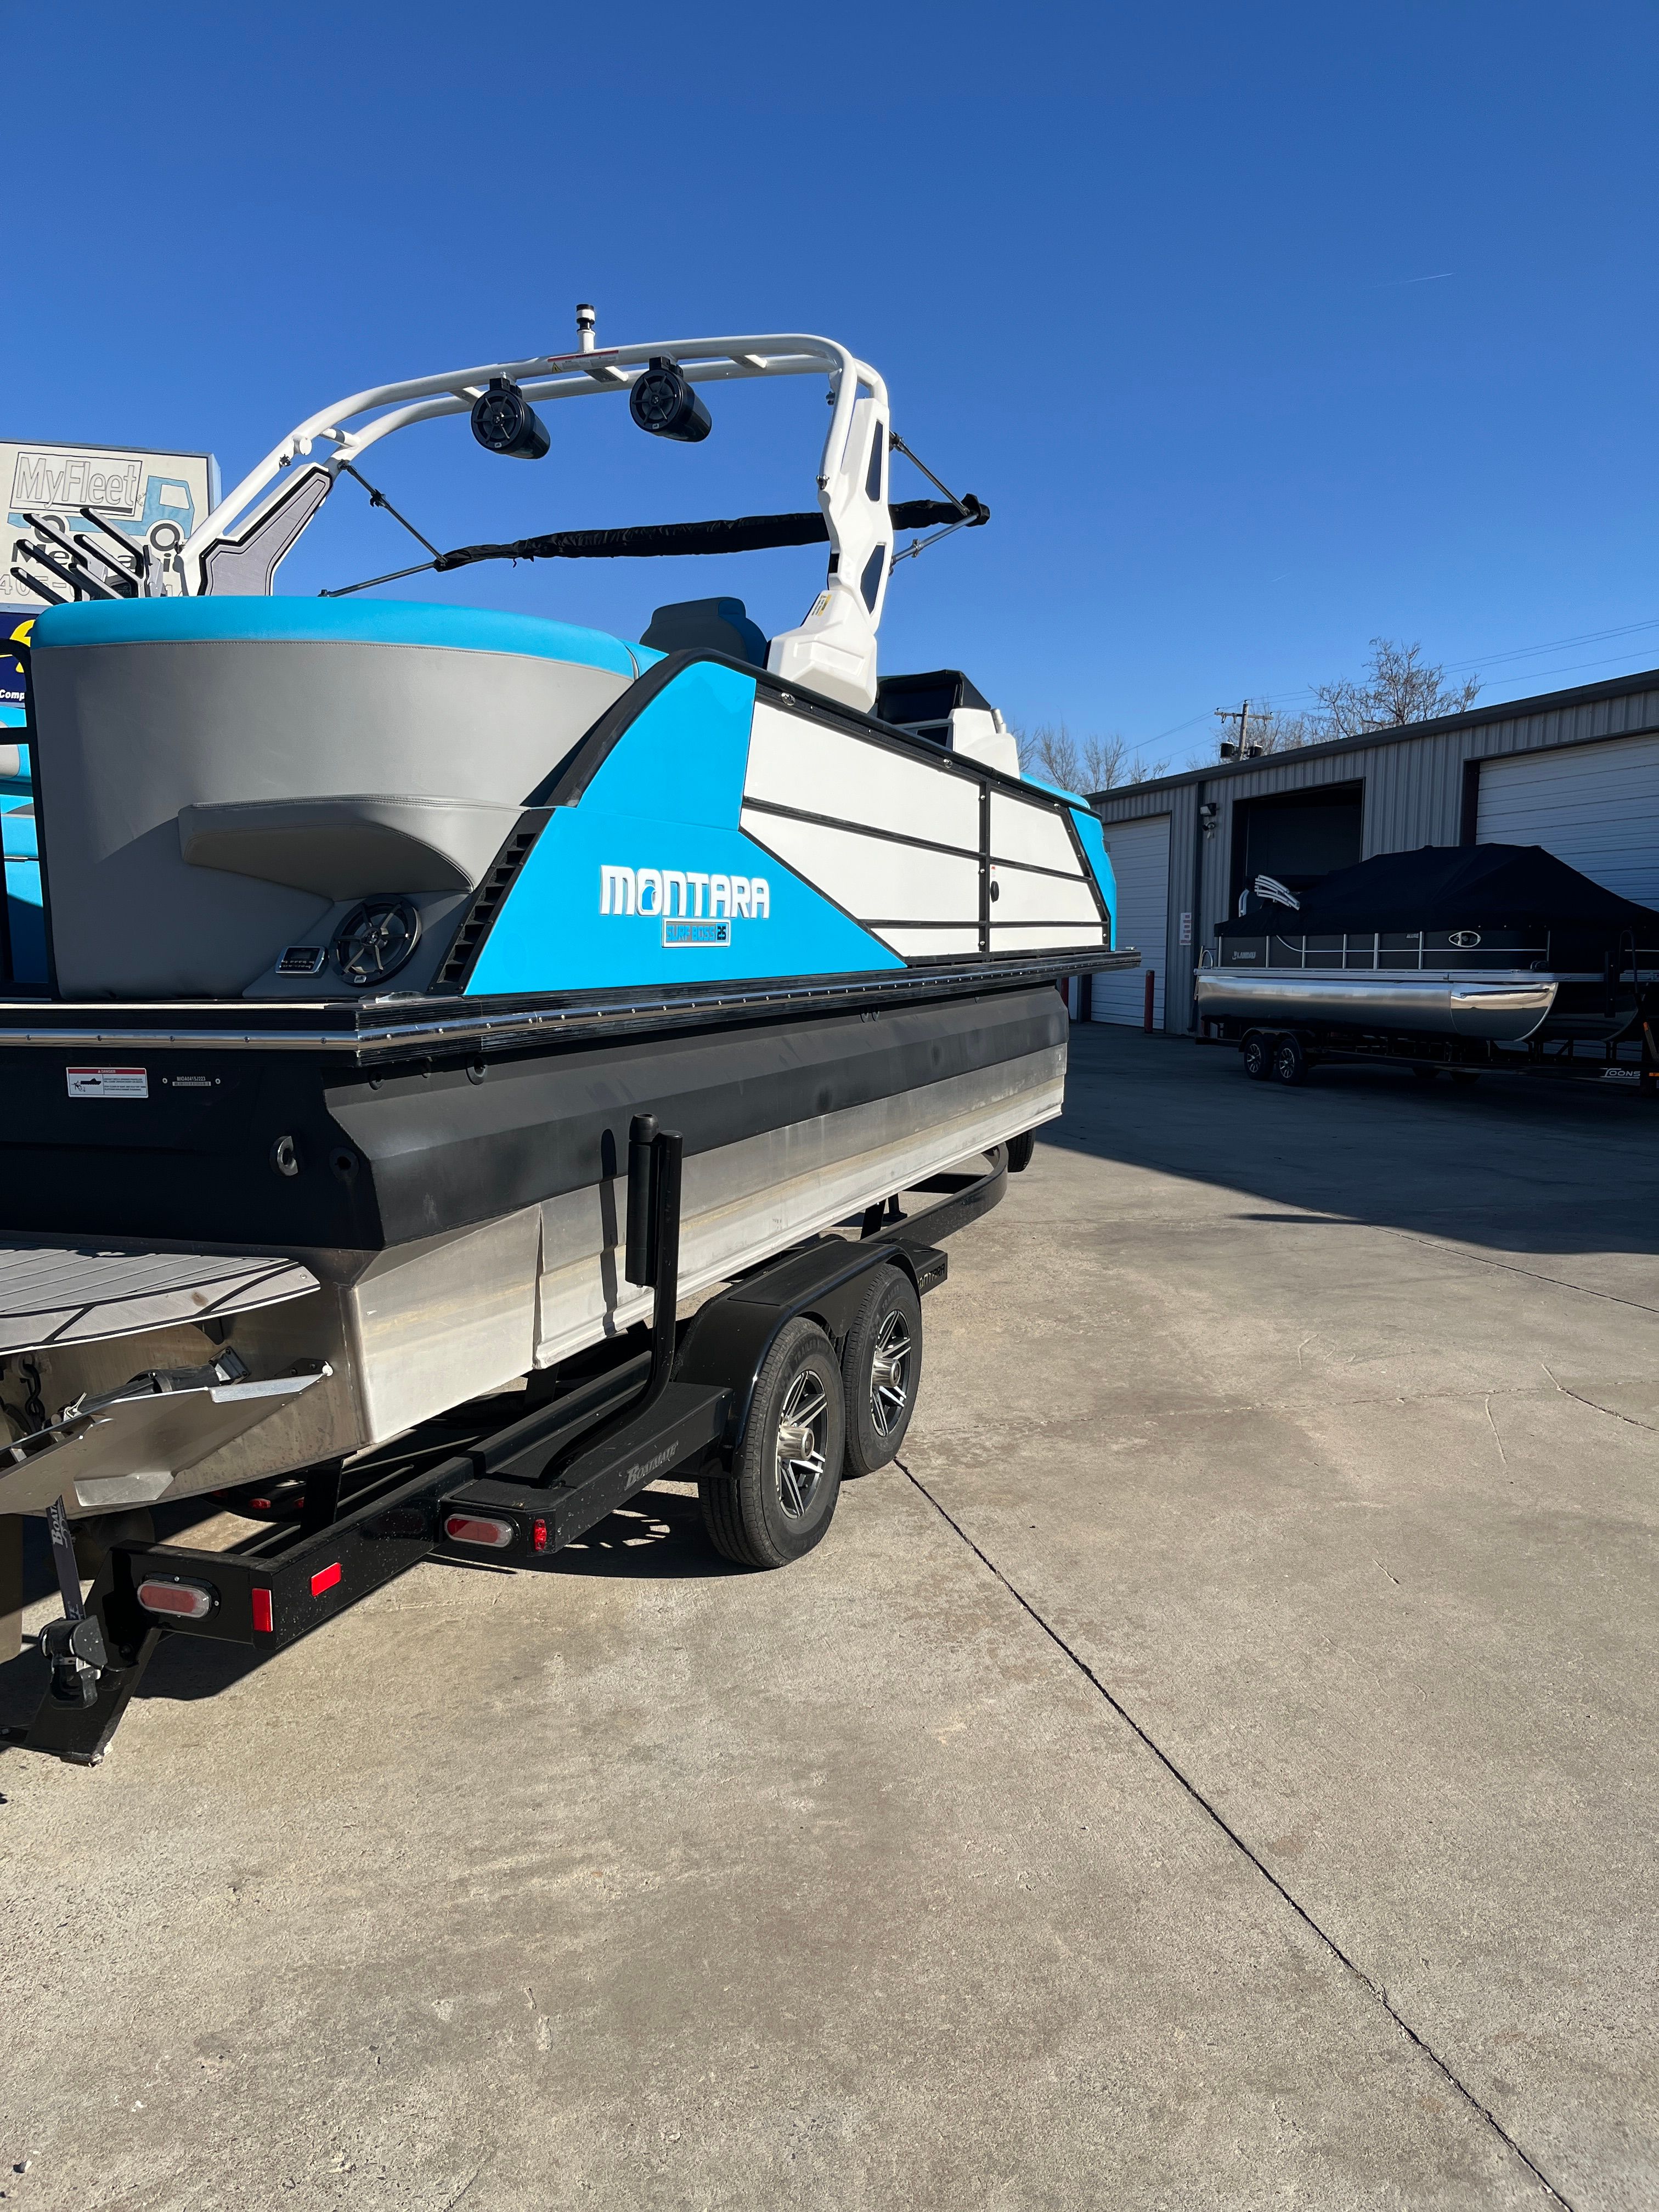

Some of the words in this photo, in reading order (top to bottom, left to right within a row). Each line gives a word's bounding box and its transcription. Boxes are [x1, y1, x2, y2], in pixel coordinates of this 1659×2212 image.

[16, 457, 137, 509] MyFleet
[599, 865, 770, 919] MONTARA
[666, 926, 691, 941] SURF
[692, 926, 715, 941] BOSS
[716, 926, 727, 941] 25
[917, 1263, 945, 1290] ONTARA
